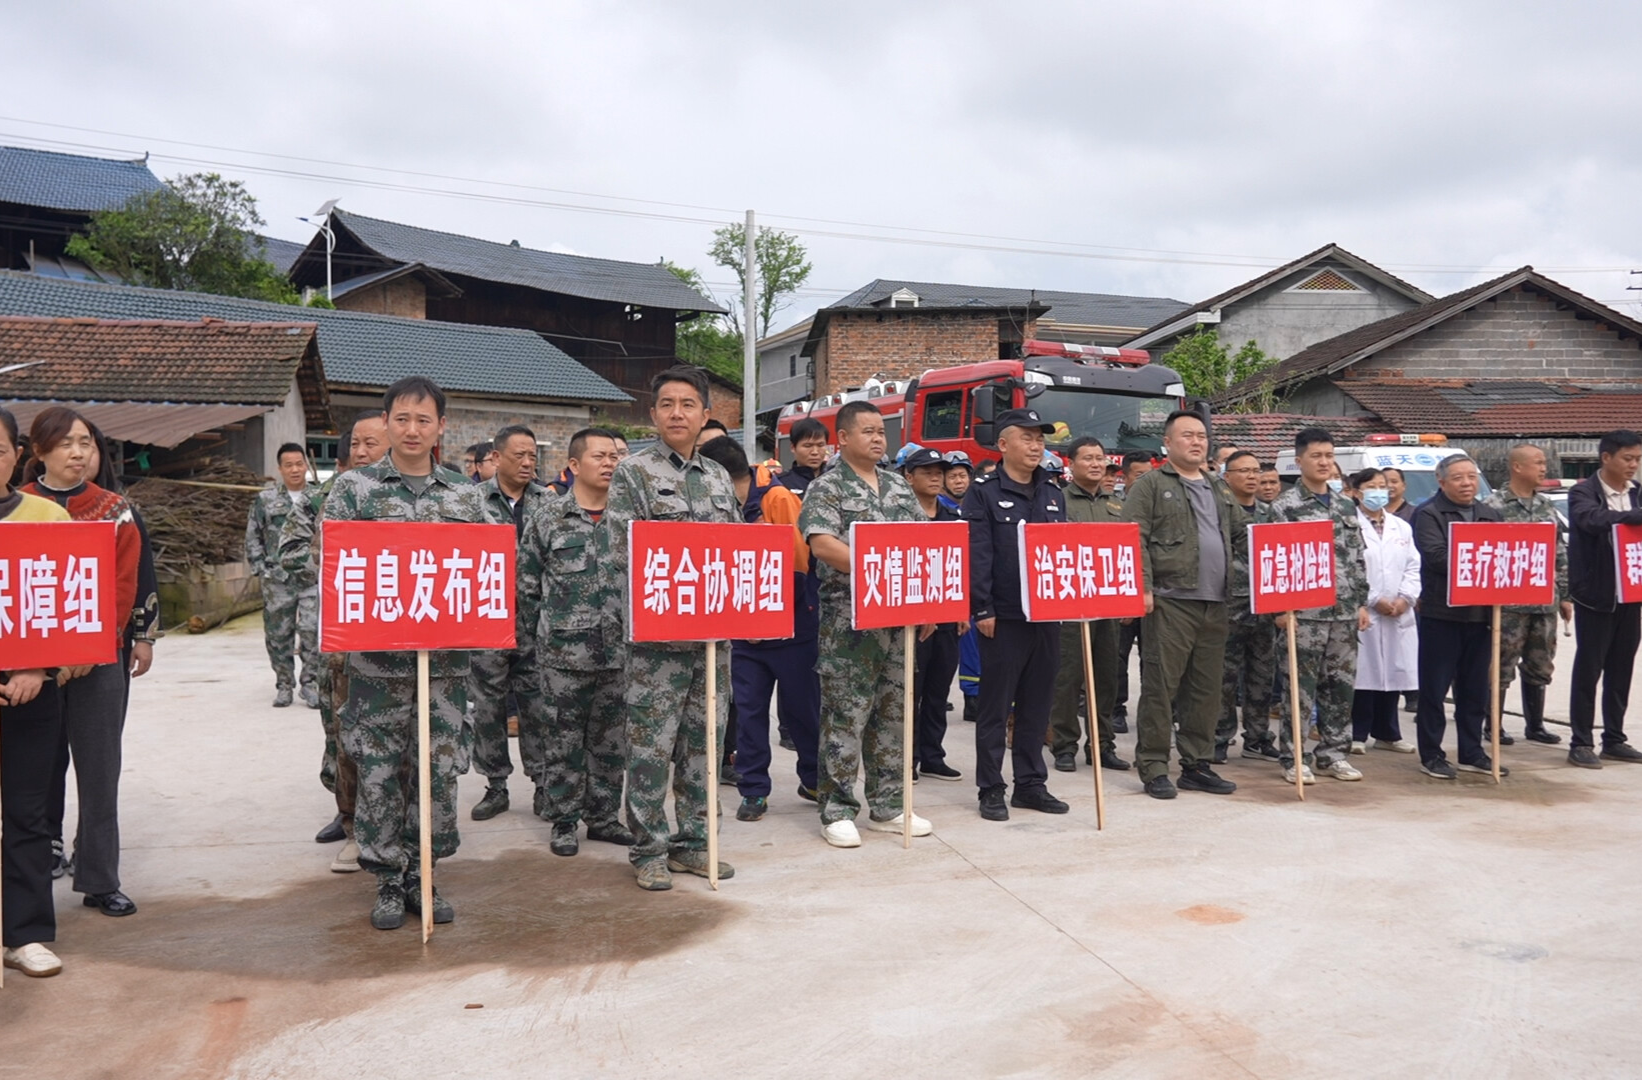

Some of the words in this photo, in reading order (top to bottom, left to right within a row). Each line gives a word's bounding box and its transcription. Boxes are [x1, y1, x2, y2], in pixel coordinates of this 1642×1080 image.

[334, 548, 509, 623] 信息发布组
[643, 547, 784, 616] 综合协调组
[863, 545, 963, 607] 灾情监测组
[1035, 544, 1138, 600] 治安保卫组
[1260, 541, 1332, 595] 应急抢险组
[1457, 541, 1547, 588] 医疗救护组
